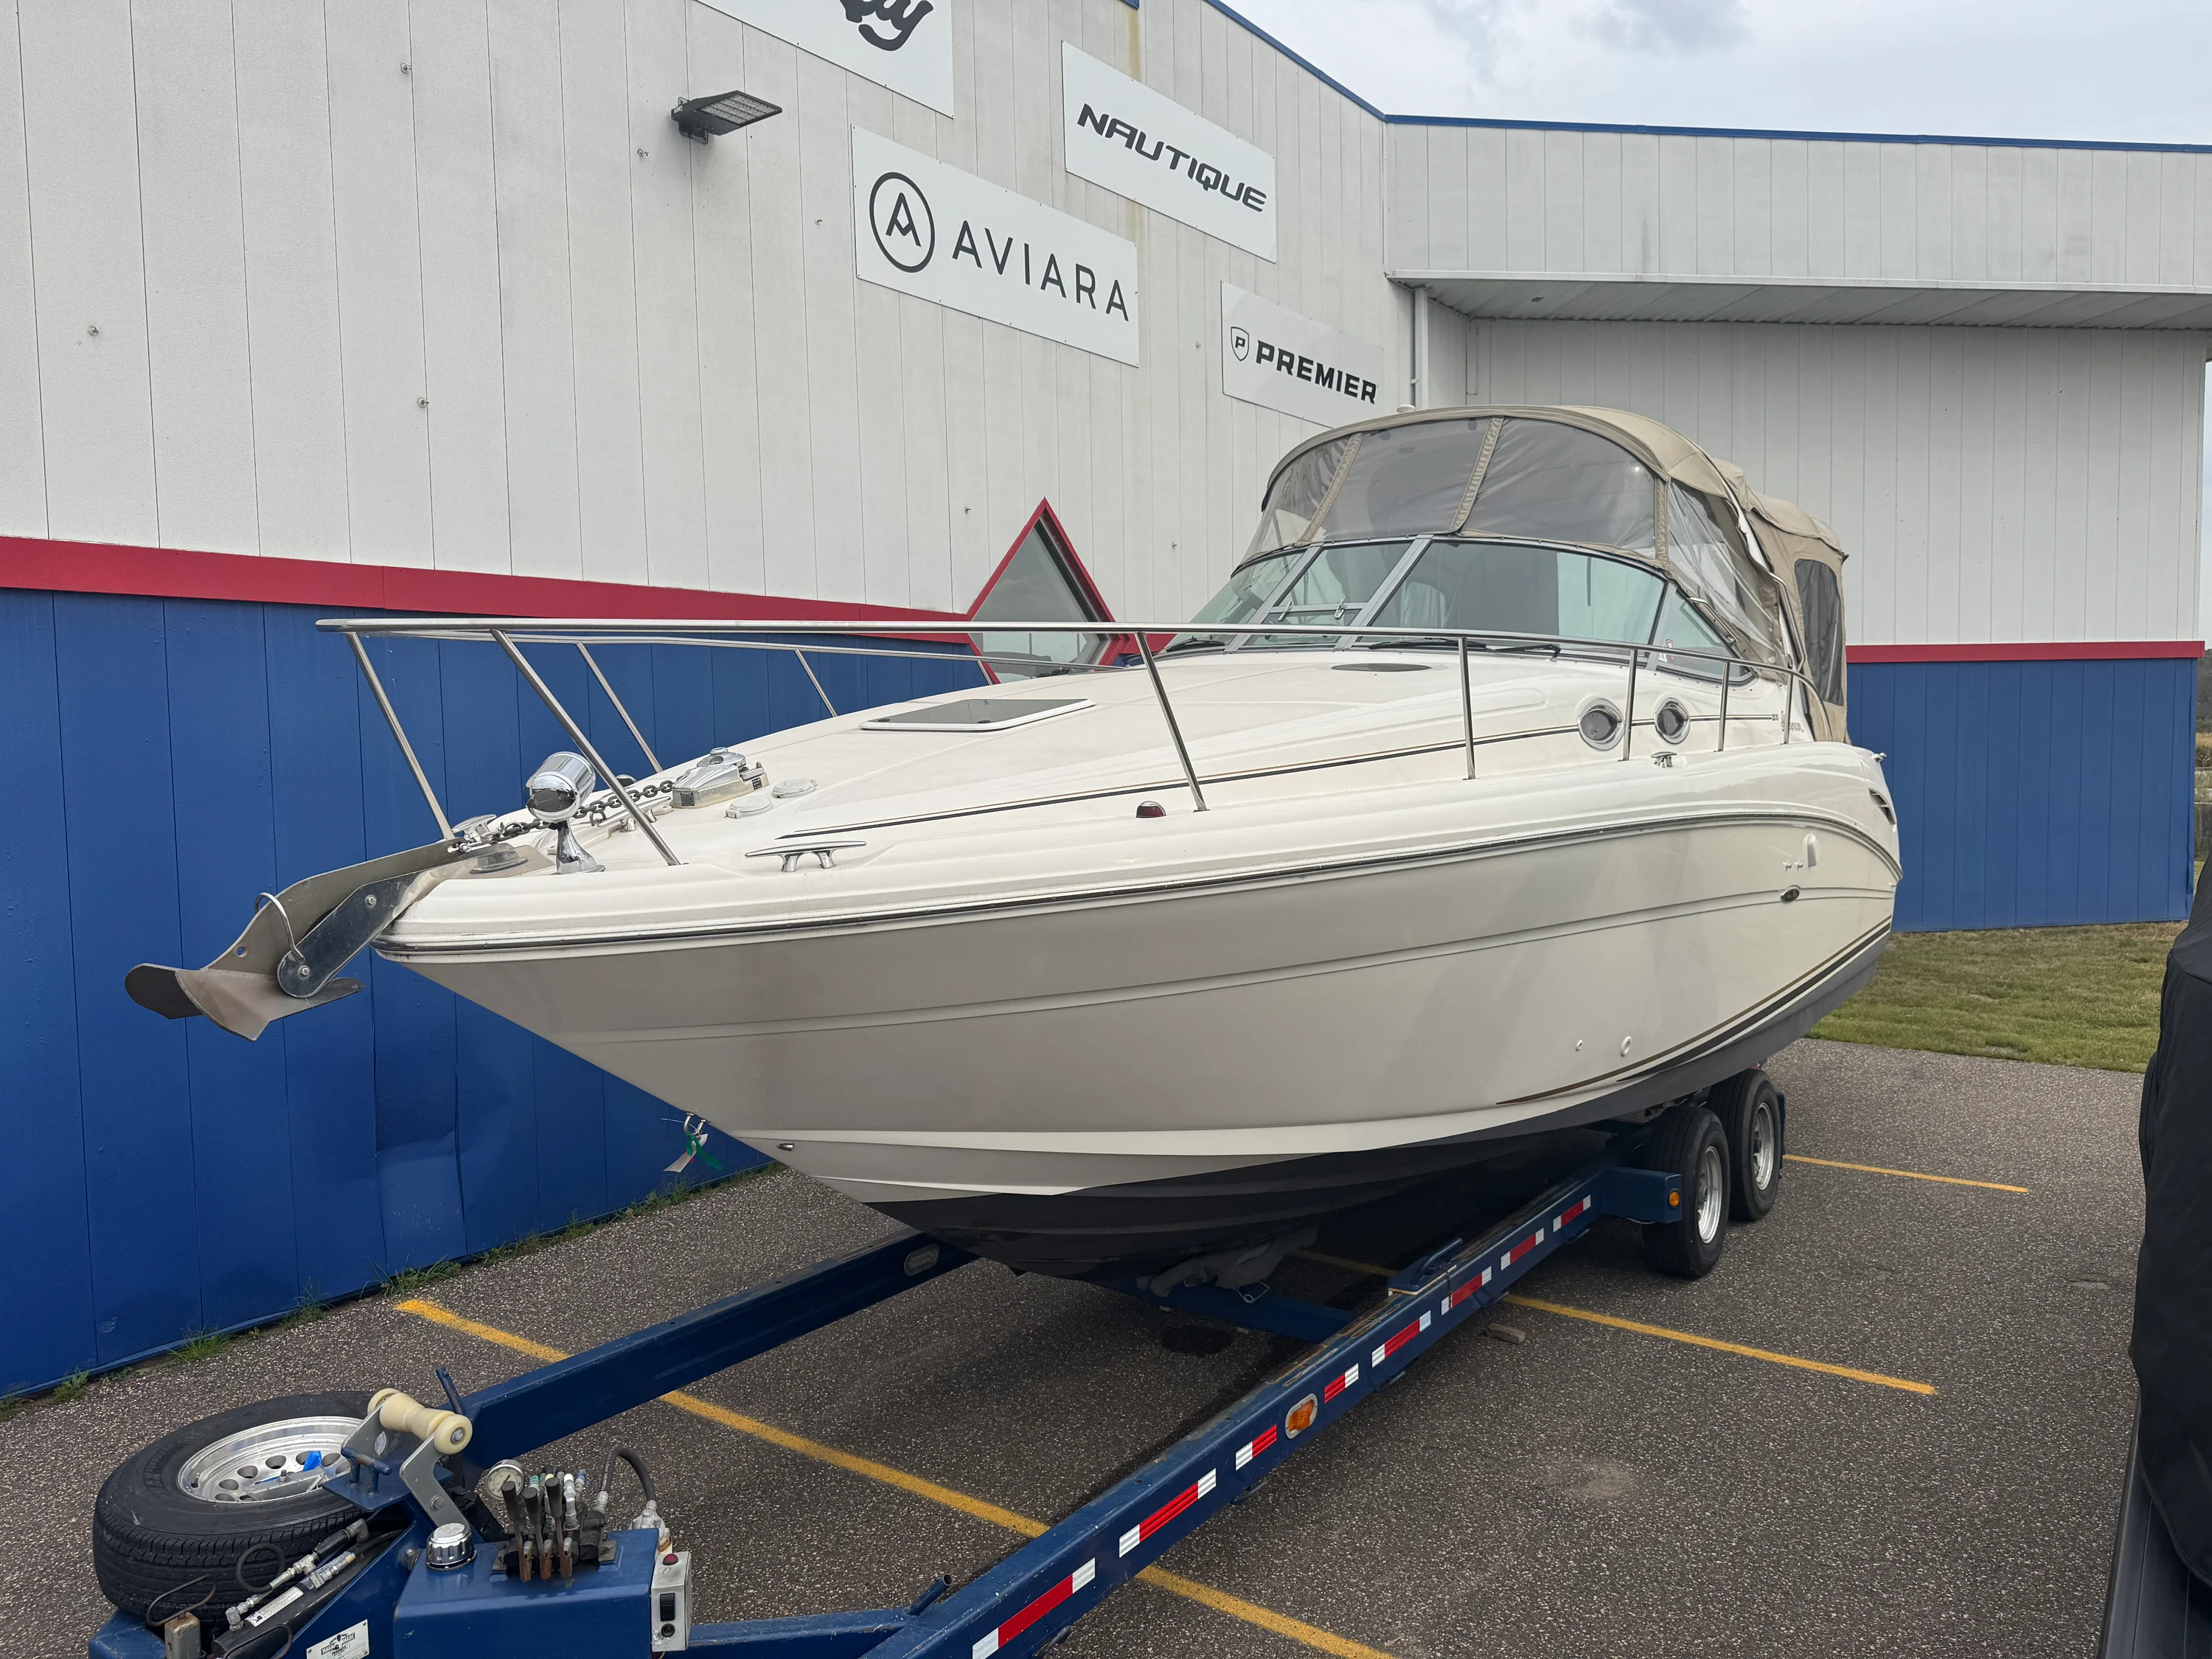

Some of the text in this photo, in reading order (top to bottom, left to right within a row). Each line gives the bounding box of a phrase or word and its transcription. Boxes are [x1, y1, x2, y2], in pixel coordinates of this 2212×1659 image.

[1077, 103, 1267, 212] NAUTIQUE
[952, 220, 1129, 321] AVIARA
[1256, 340, 1377, 405] PREMIER
